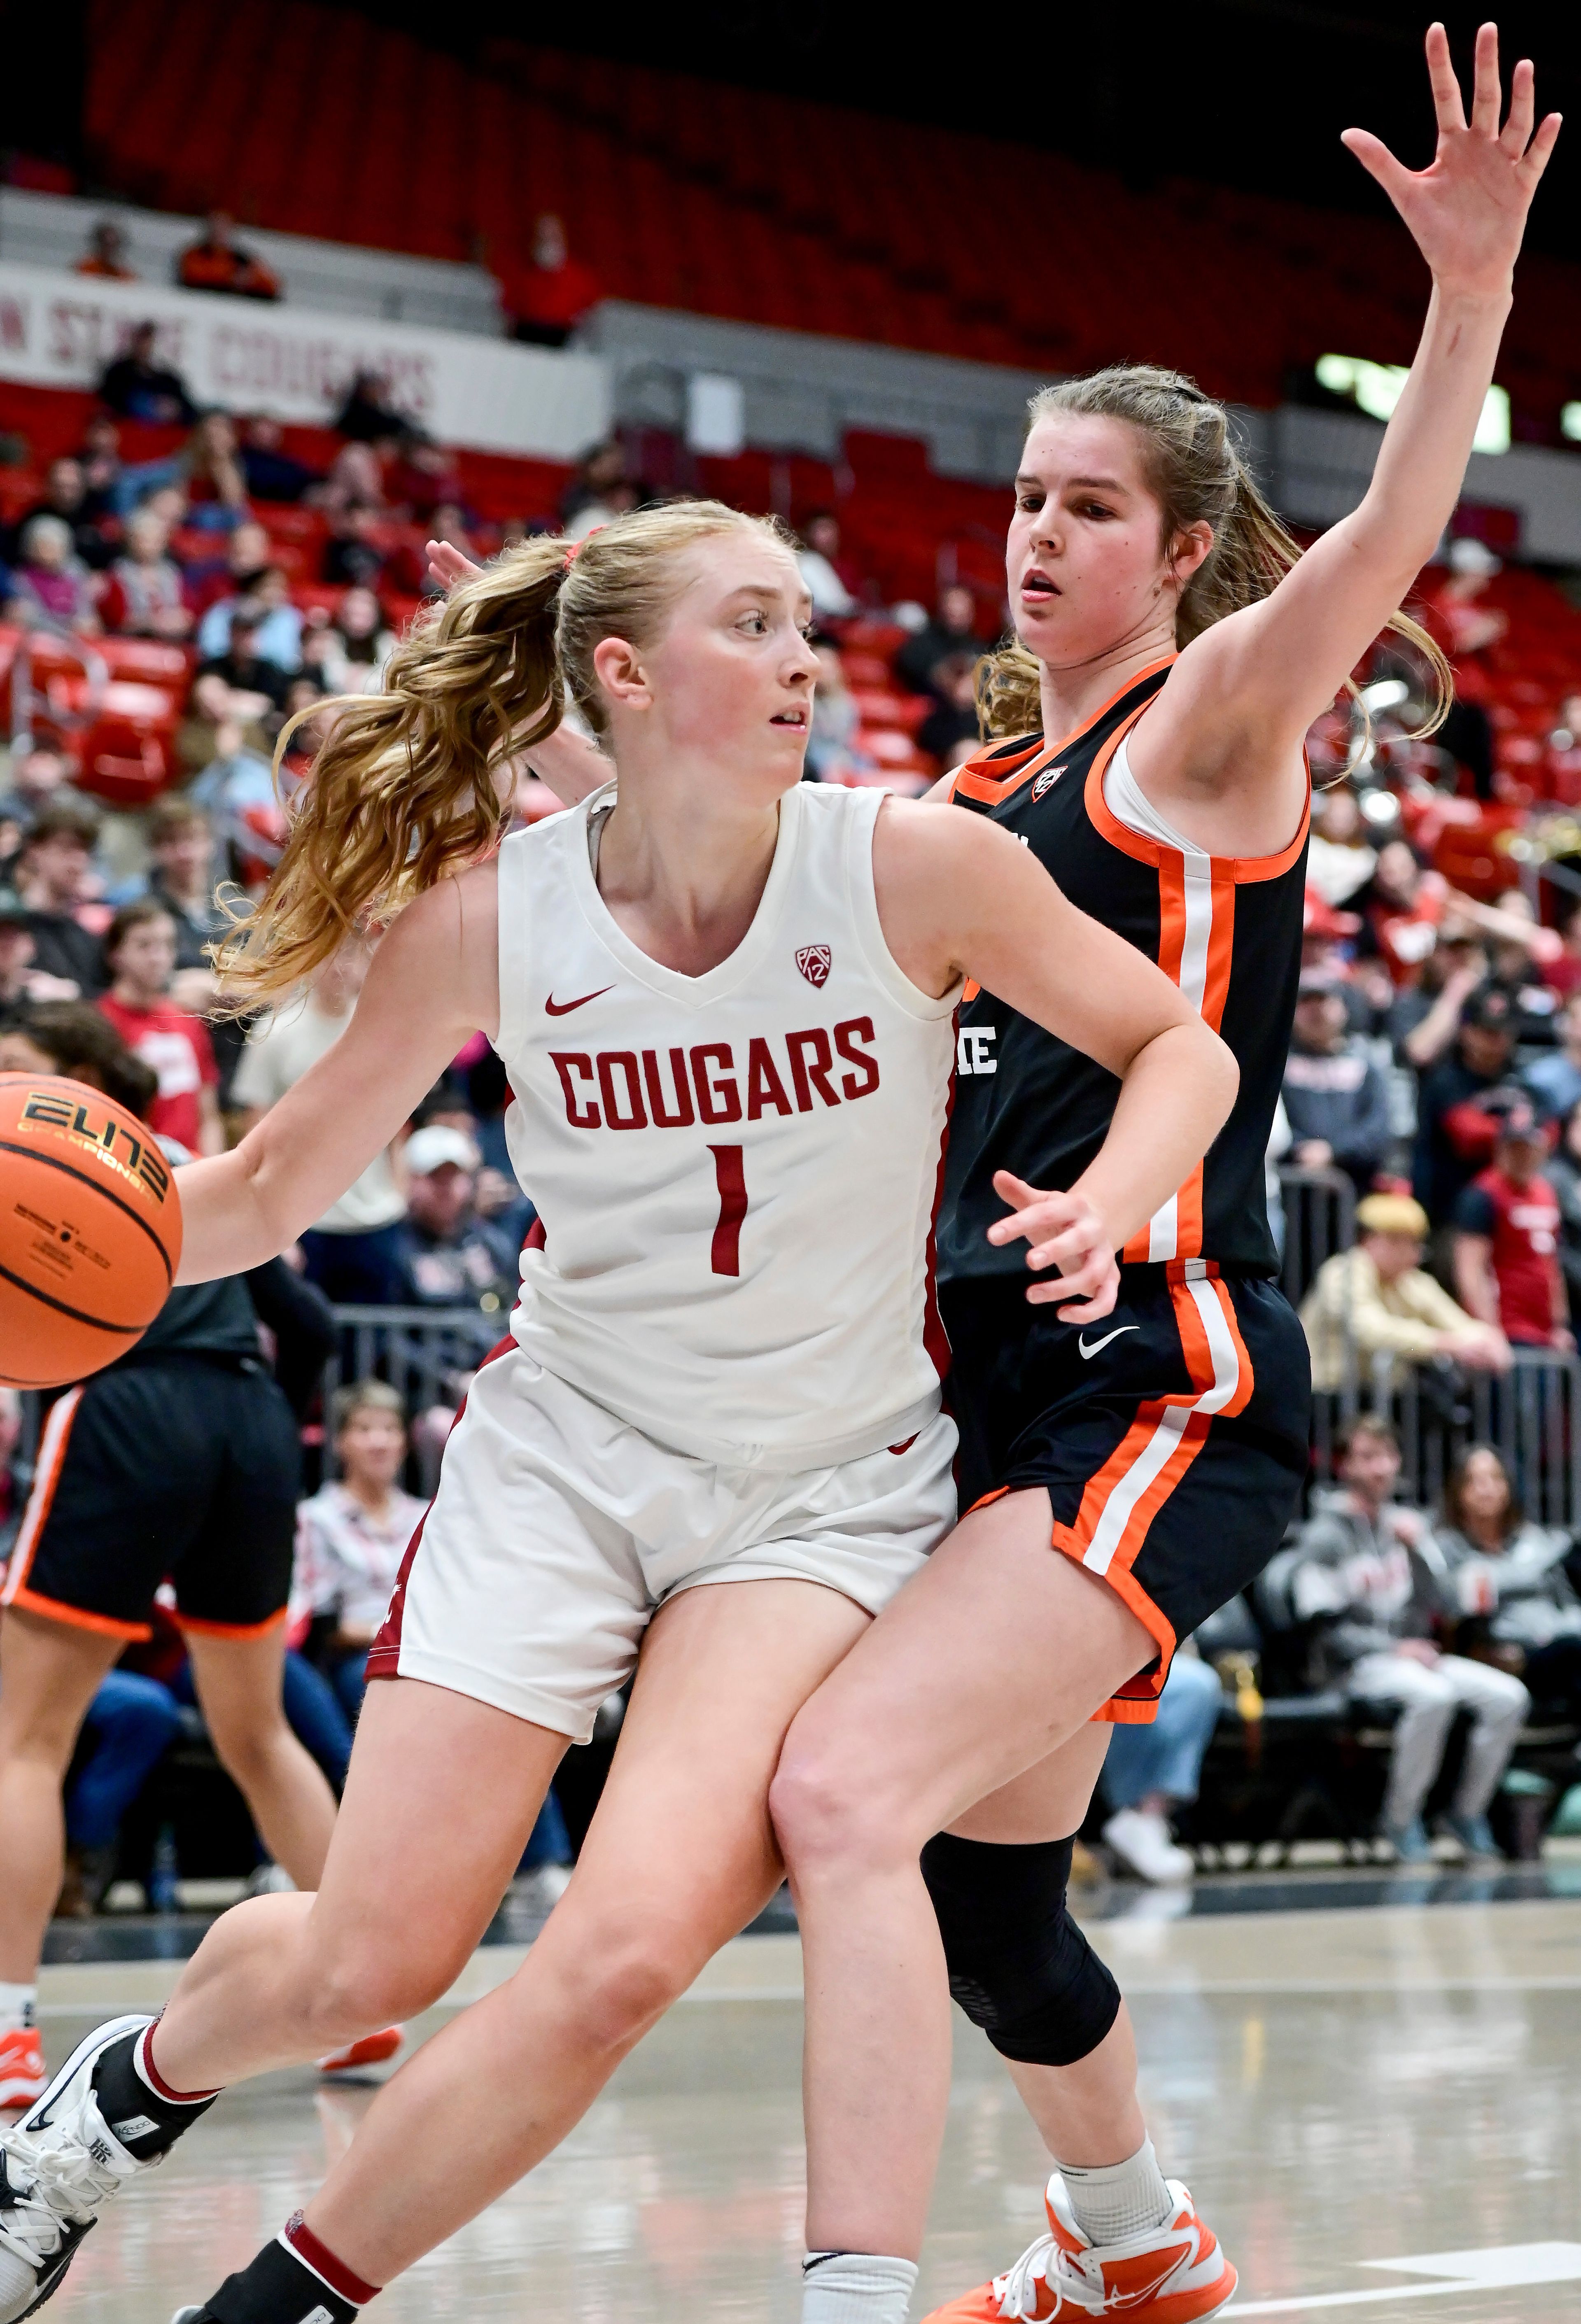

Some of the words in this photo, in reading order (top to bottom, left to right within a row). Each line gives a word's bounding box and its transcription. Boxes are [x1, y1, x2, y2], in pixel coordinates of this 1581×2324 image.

[49, 299, 185, 363] STAE
[796, 946, 830, 974] PAC
[807, 963, 826, 981] 12
[548, 1016, 880, 1130] COUGARS
[17, 1121, 159, 1208] CHAMPIONSH
[23, 1092, 168, 1203] ELITE
[706, 1145, 748, 1277] 1
